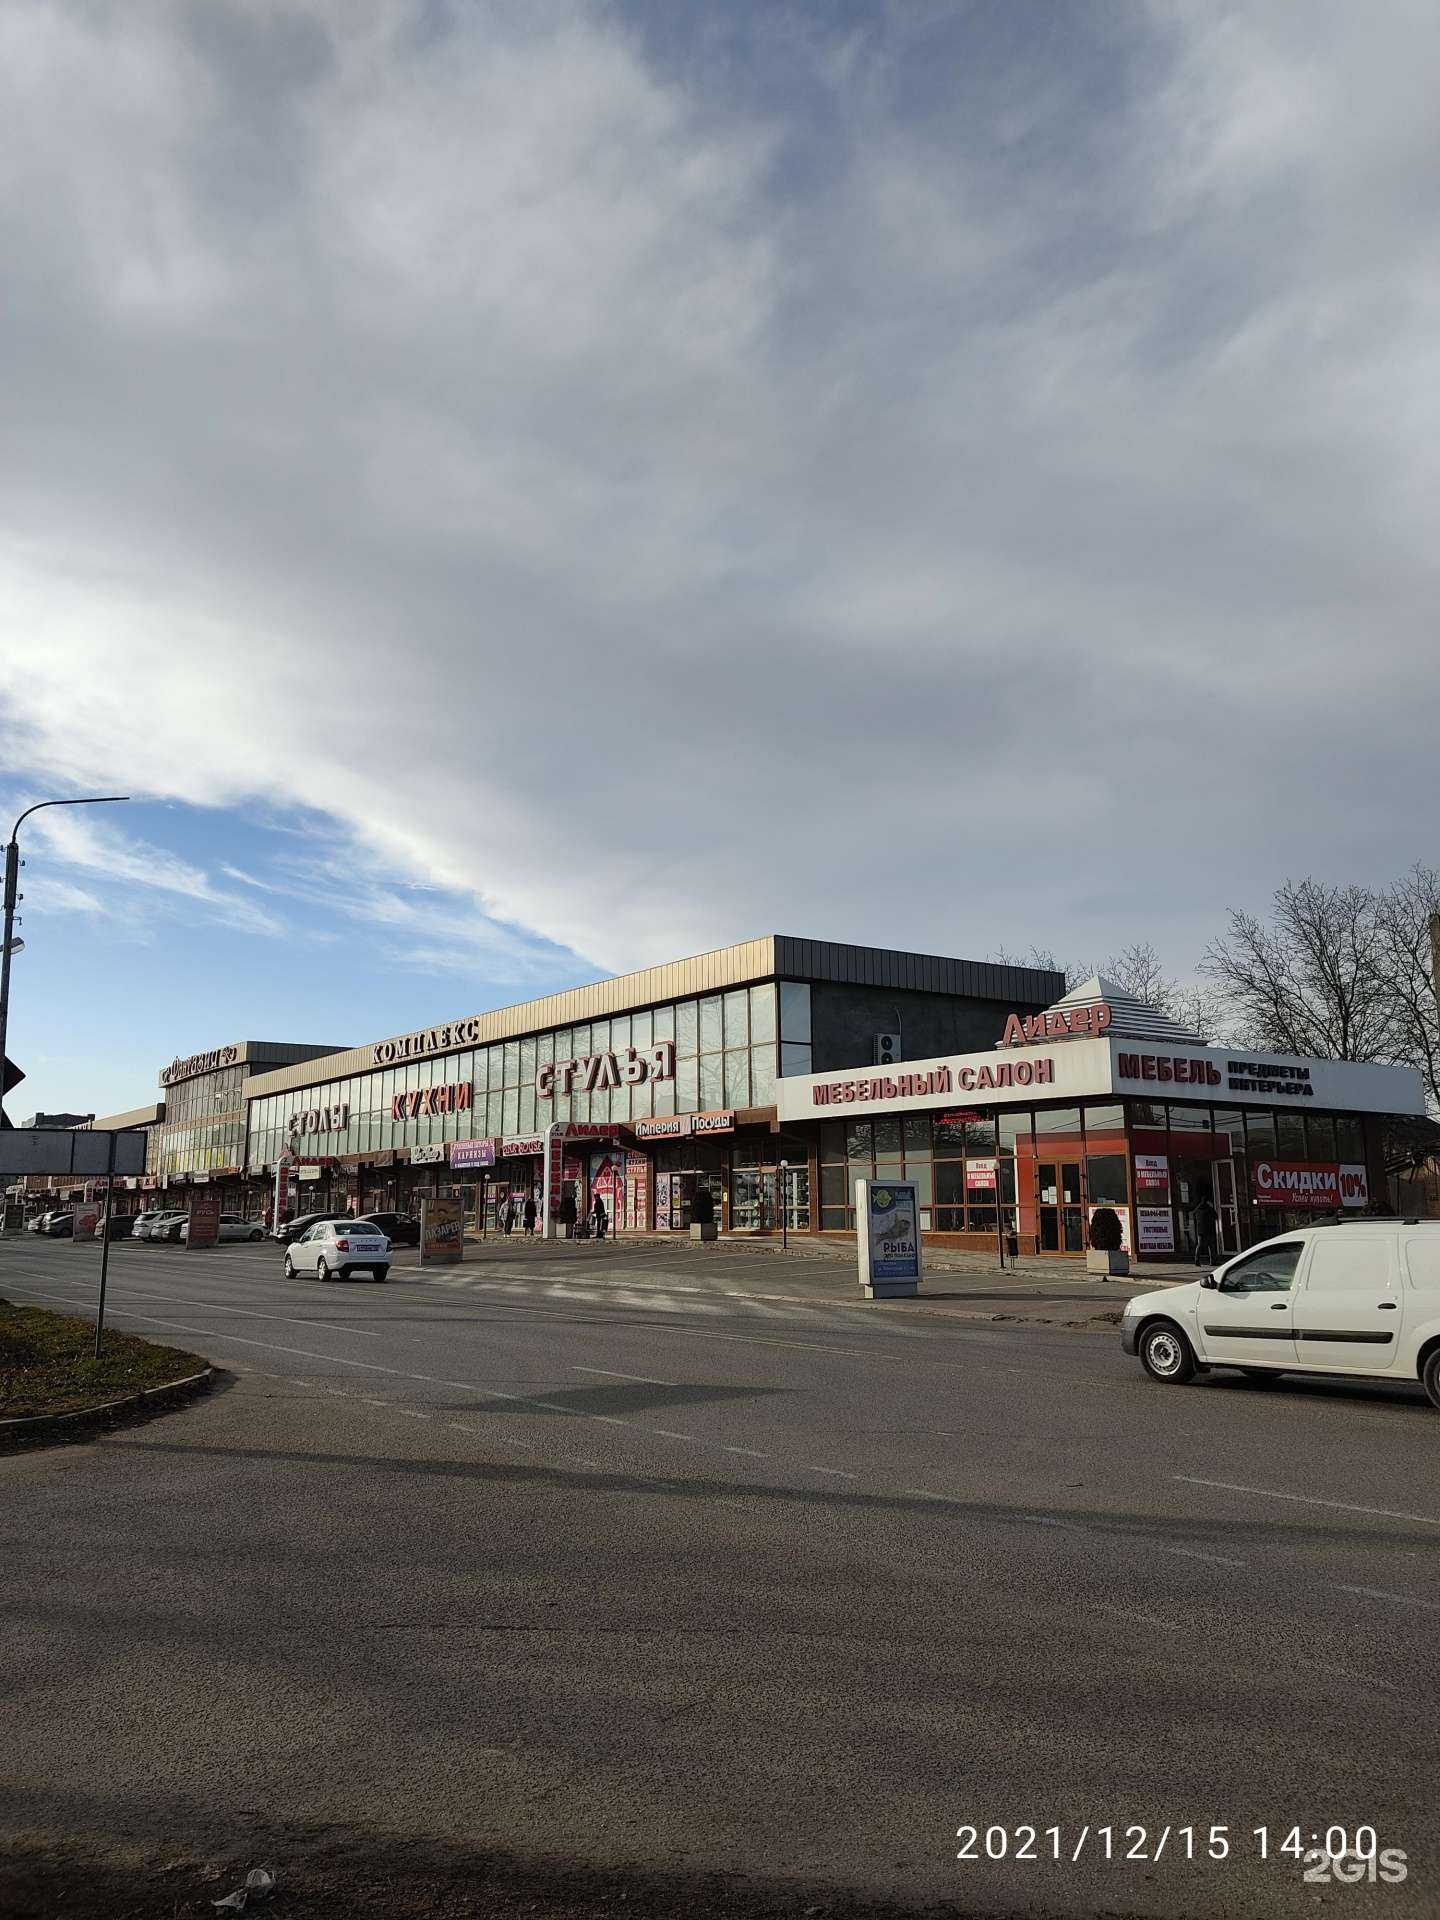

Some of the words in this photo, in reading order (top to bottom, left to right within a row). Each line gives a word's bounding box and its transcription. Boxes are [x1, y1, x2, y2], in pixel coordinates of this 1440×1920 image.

[373, 1019, 479, 1064] КОМПЛЕКС
[1002, 1003, 1111, 1047] Лидер
[536, 1040, 677, 1099] СТУЛЬЯ
[812, 1065, 952, 1106] МЕБЕЛЬНЫЙ
[957, 1058, 1055, 1091] САЛОН
[1118, 1052, 1222, 1085] МЕБЕЛЬ
[1228, 1060, 1310, 1080] ПРЕДМЕТЫ
[391, 1081, 474, 1122] КУХНИ
[1228, 1077, 1314, 1096] ИНТЕРЬЕРА
[288, 1103, 350, 1138] СТОЛЫ
[635, 1121, 680, 1137] Империя
[691, 1115, 730, 1131] Посуды
[1257, 1163, 1337, 1194] Скидки
[1341, 1173, 1366, 1198] 10%
[883, 1241, 915, 1253] РЫБА
